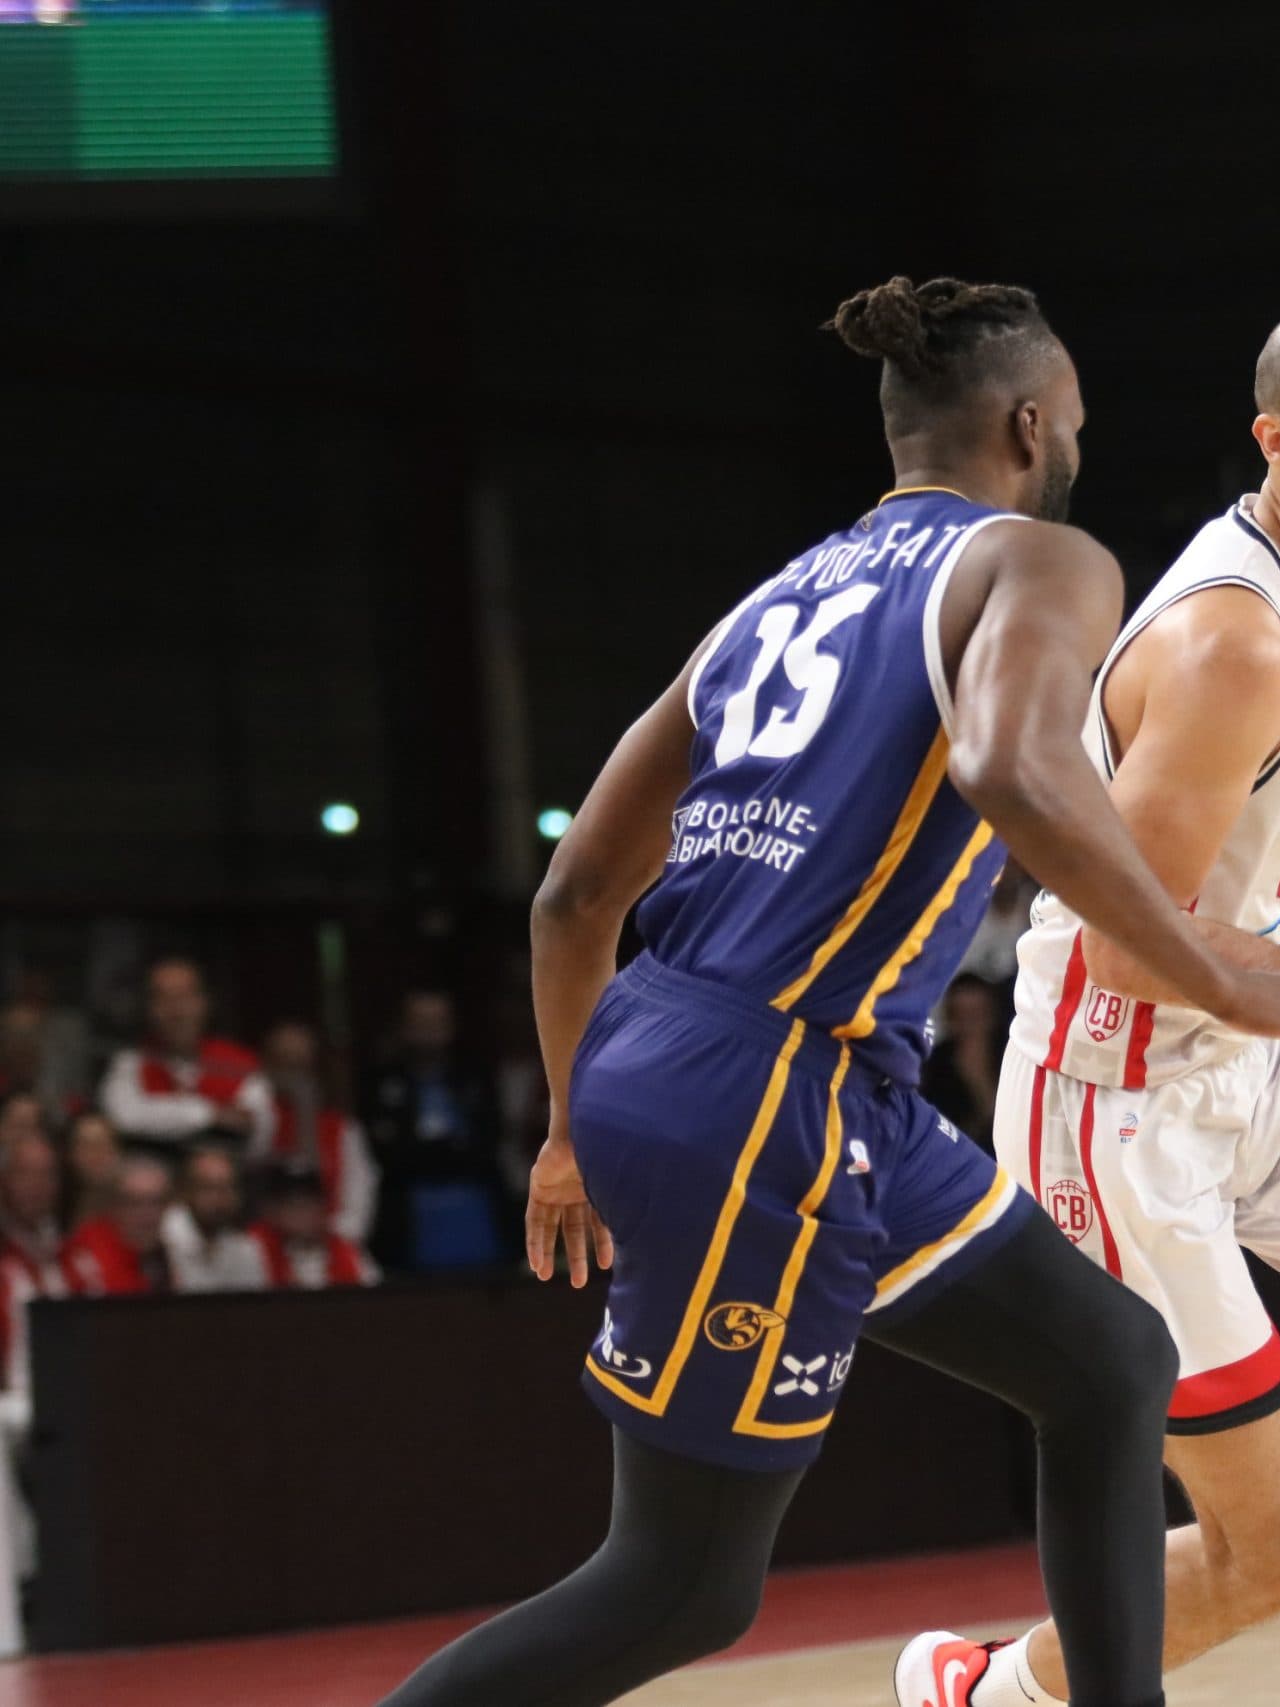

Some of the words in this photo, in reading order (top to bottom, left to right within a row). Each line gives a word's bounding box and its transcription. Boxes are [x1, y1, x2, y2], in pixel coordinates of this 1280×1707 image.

[714, 584, 880, 769] 15
[1089, 991, 1122, 1031] CB
[1053, 1194, 1086, 1231] CB
